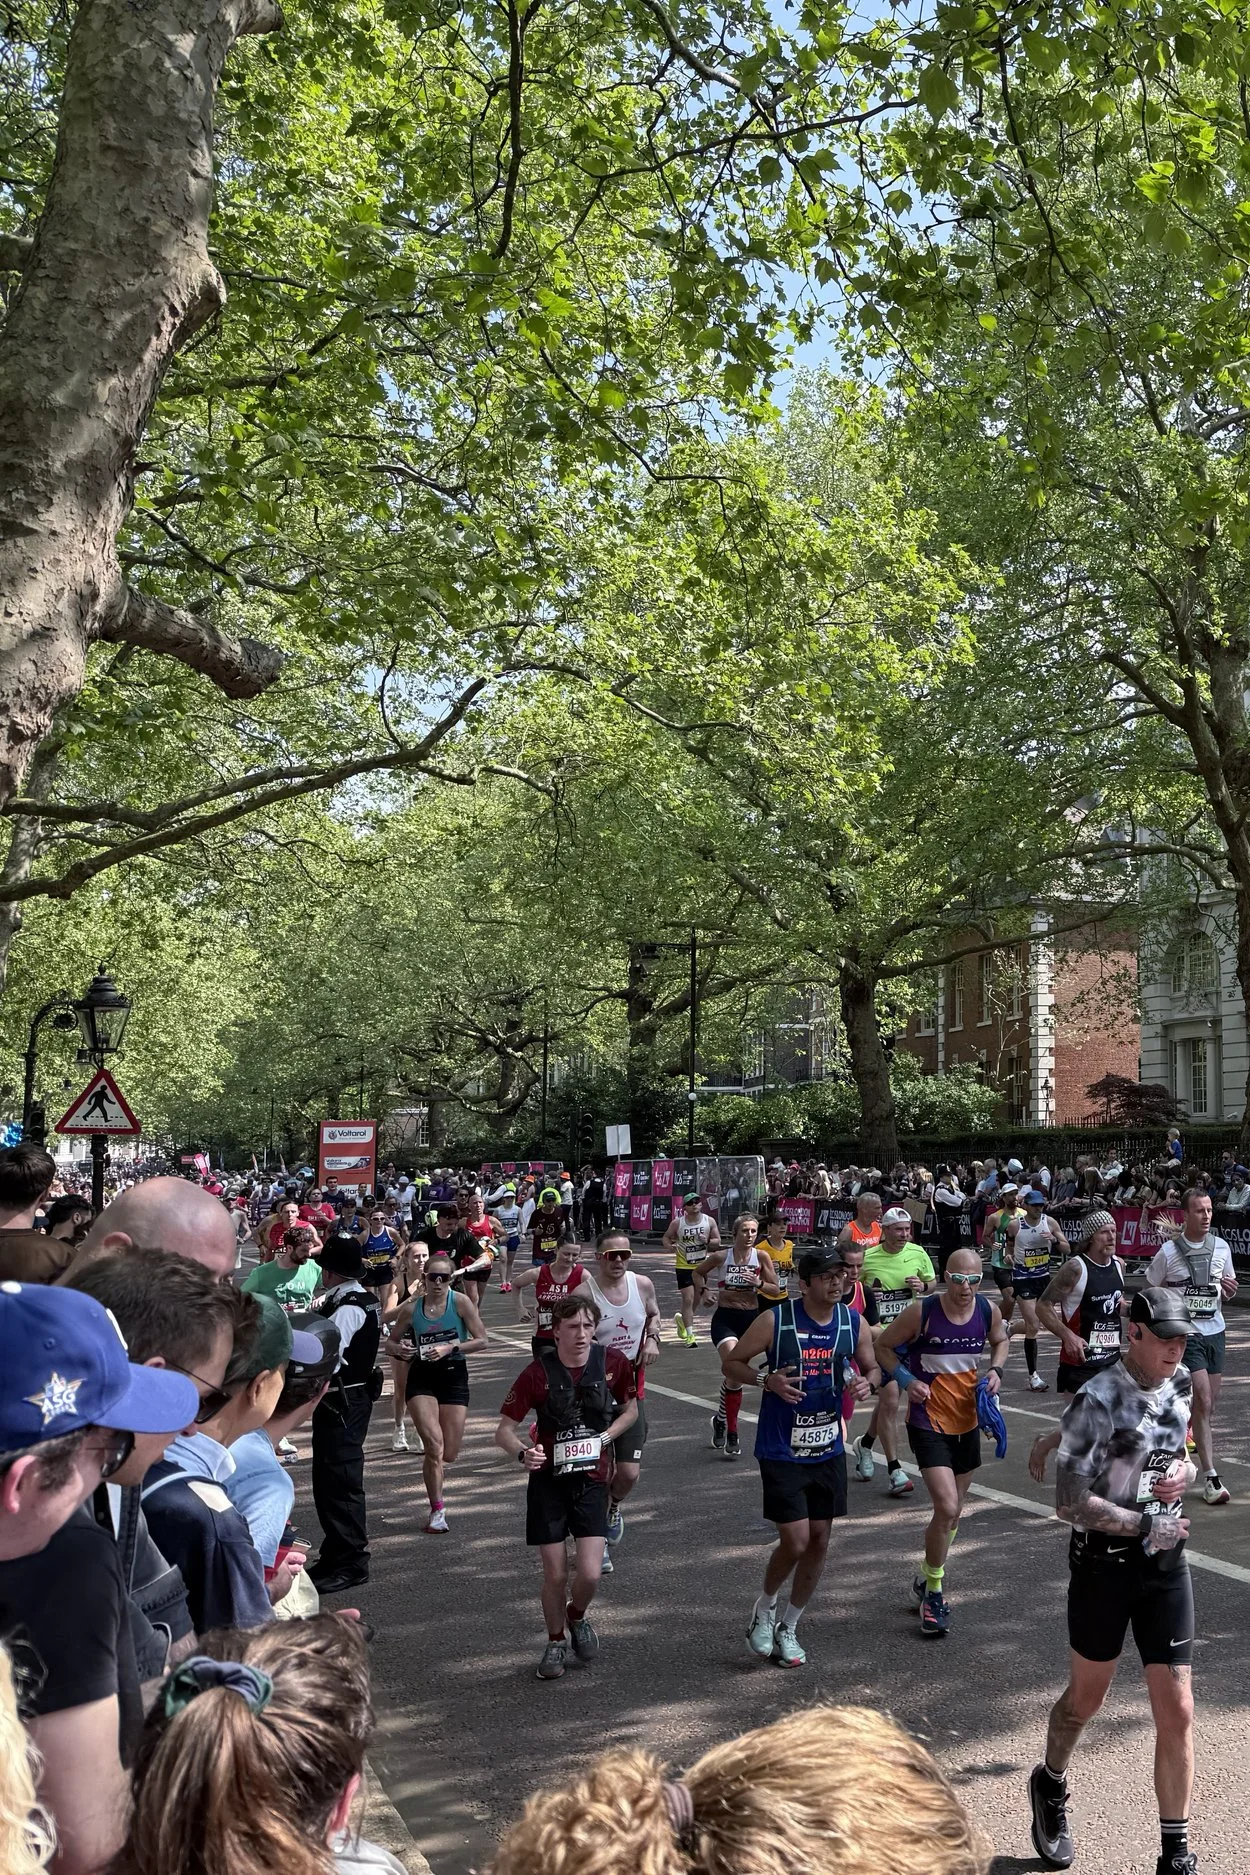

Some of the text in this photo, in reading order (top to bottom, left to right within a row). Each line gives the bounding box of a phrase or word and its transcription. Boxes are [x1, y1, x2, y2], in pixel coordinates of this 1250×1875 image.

[684, 1227, 704, 1235] PETE
[549, 1284, 568, 1293] ASH
[1094, 1320, 1106, 1330] tcs
[420, 1335, 435, 1344] tcs
[42, 1390, 76, 1414] ASG
[796, 1413, 815, 1425] tcs
[799, 1428, 834, 1444] 45875
[564, 1443, 592, 1457] 8940
[1148, 1453, 1165, 1468] tc
